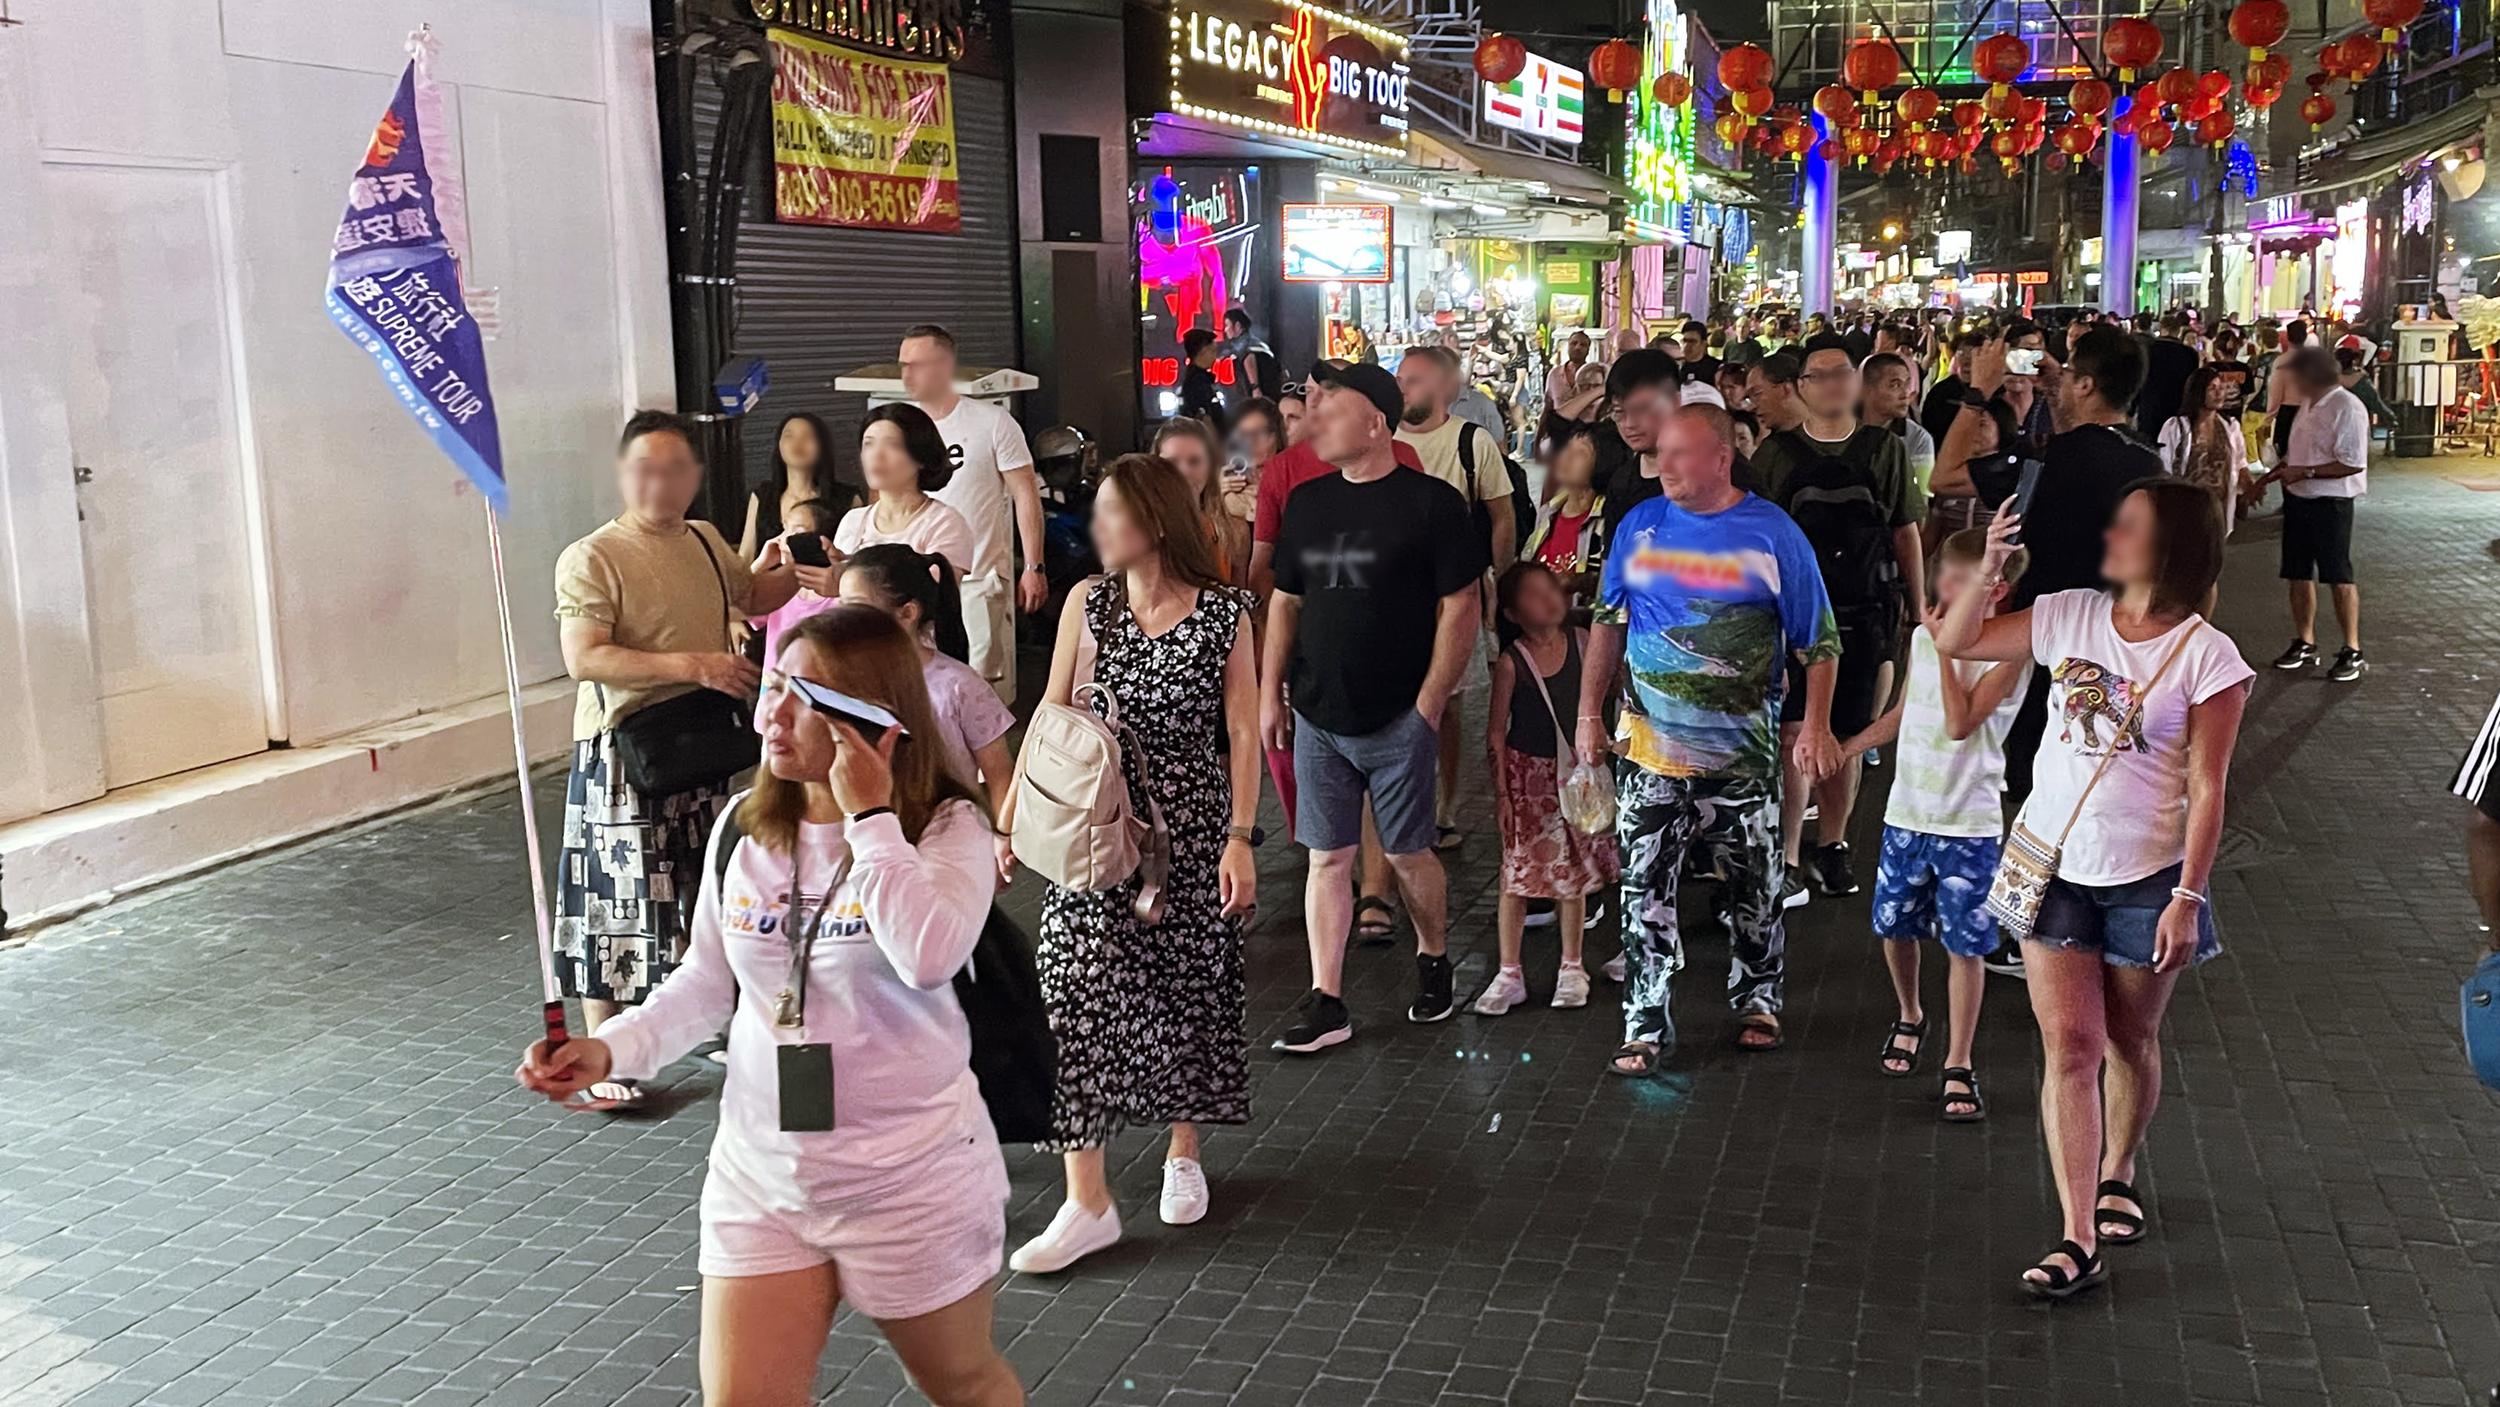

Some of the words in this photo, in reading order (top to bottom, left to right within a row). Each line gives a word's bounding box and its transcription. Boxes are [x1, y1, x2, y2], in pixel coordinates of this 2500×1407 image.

[1190, 11, 1294, 81] LEGACY
[1329, 55, 1362, 98] BIG
[861, 62, 901, 121] FOR
[901, 69, 946, 127] RENT
[366, 297, 445, 379] SUPREME
[430, 369, 484, 425] TOUR
